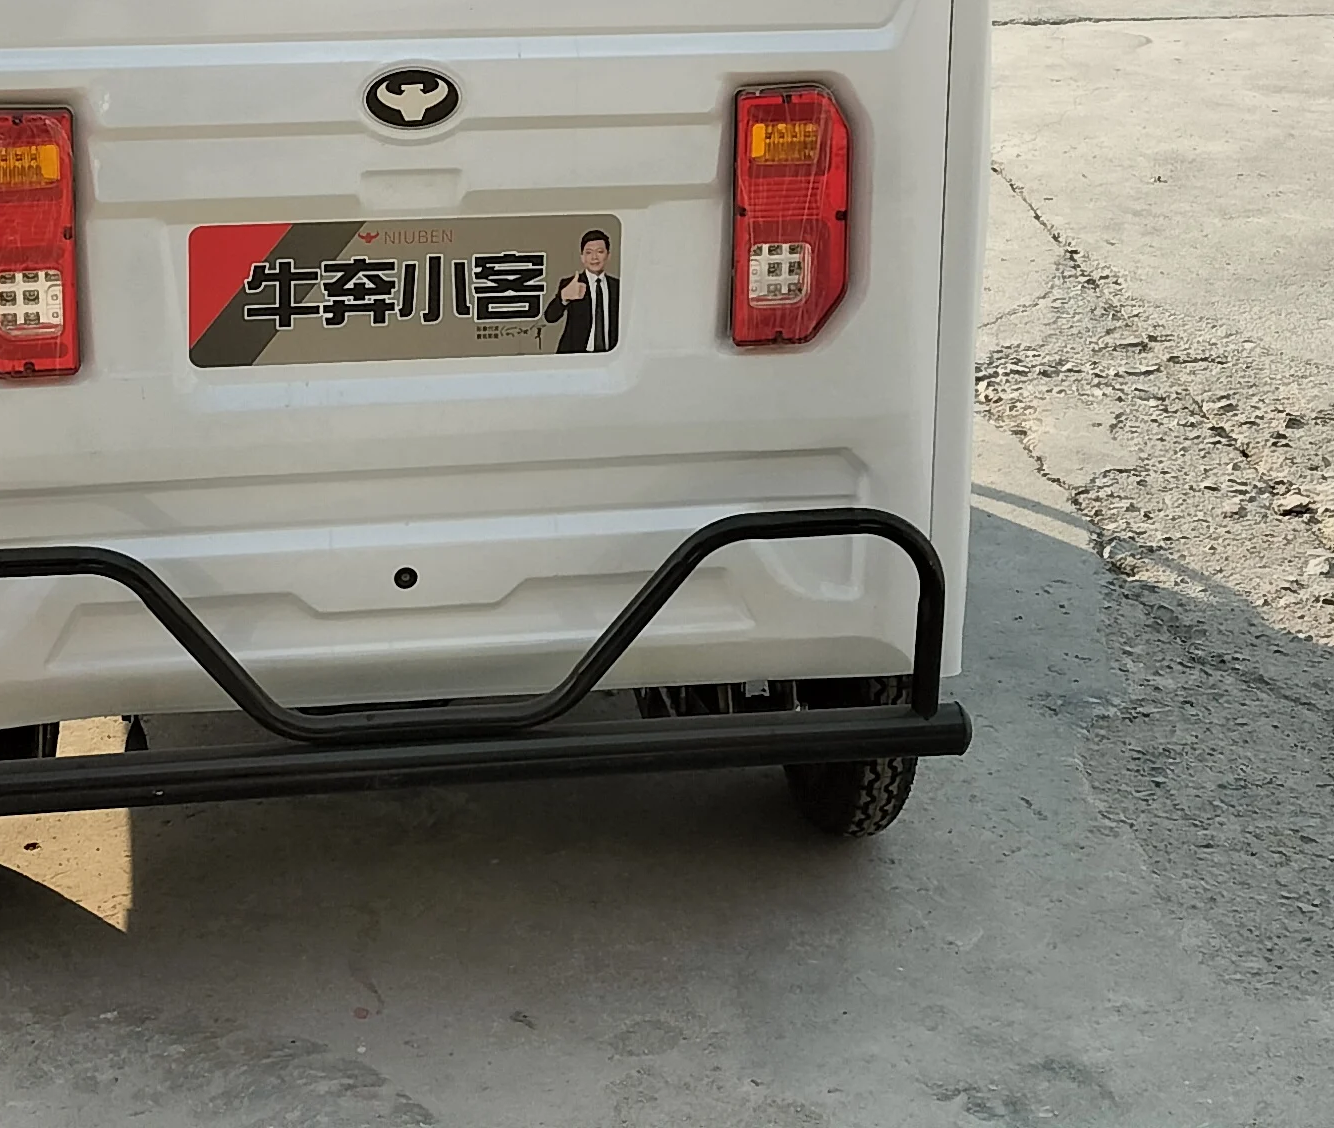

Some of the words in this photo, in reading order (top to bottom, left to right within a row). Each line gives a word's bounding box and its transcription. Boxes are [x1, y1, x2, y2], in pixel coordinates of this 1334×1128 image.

[384, 230, 453, 244] NIUBEN
[245, 252, 547, 329] 牛奔小客
